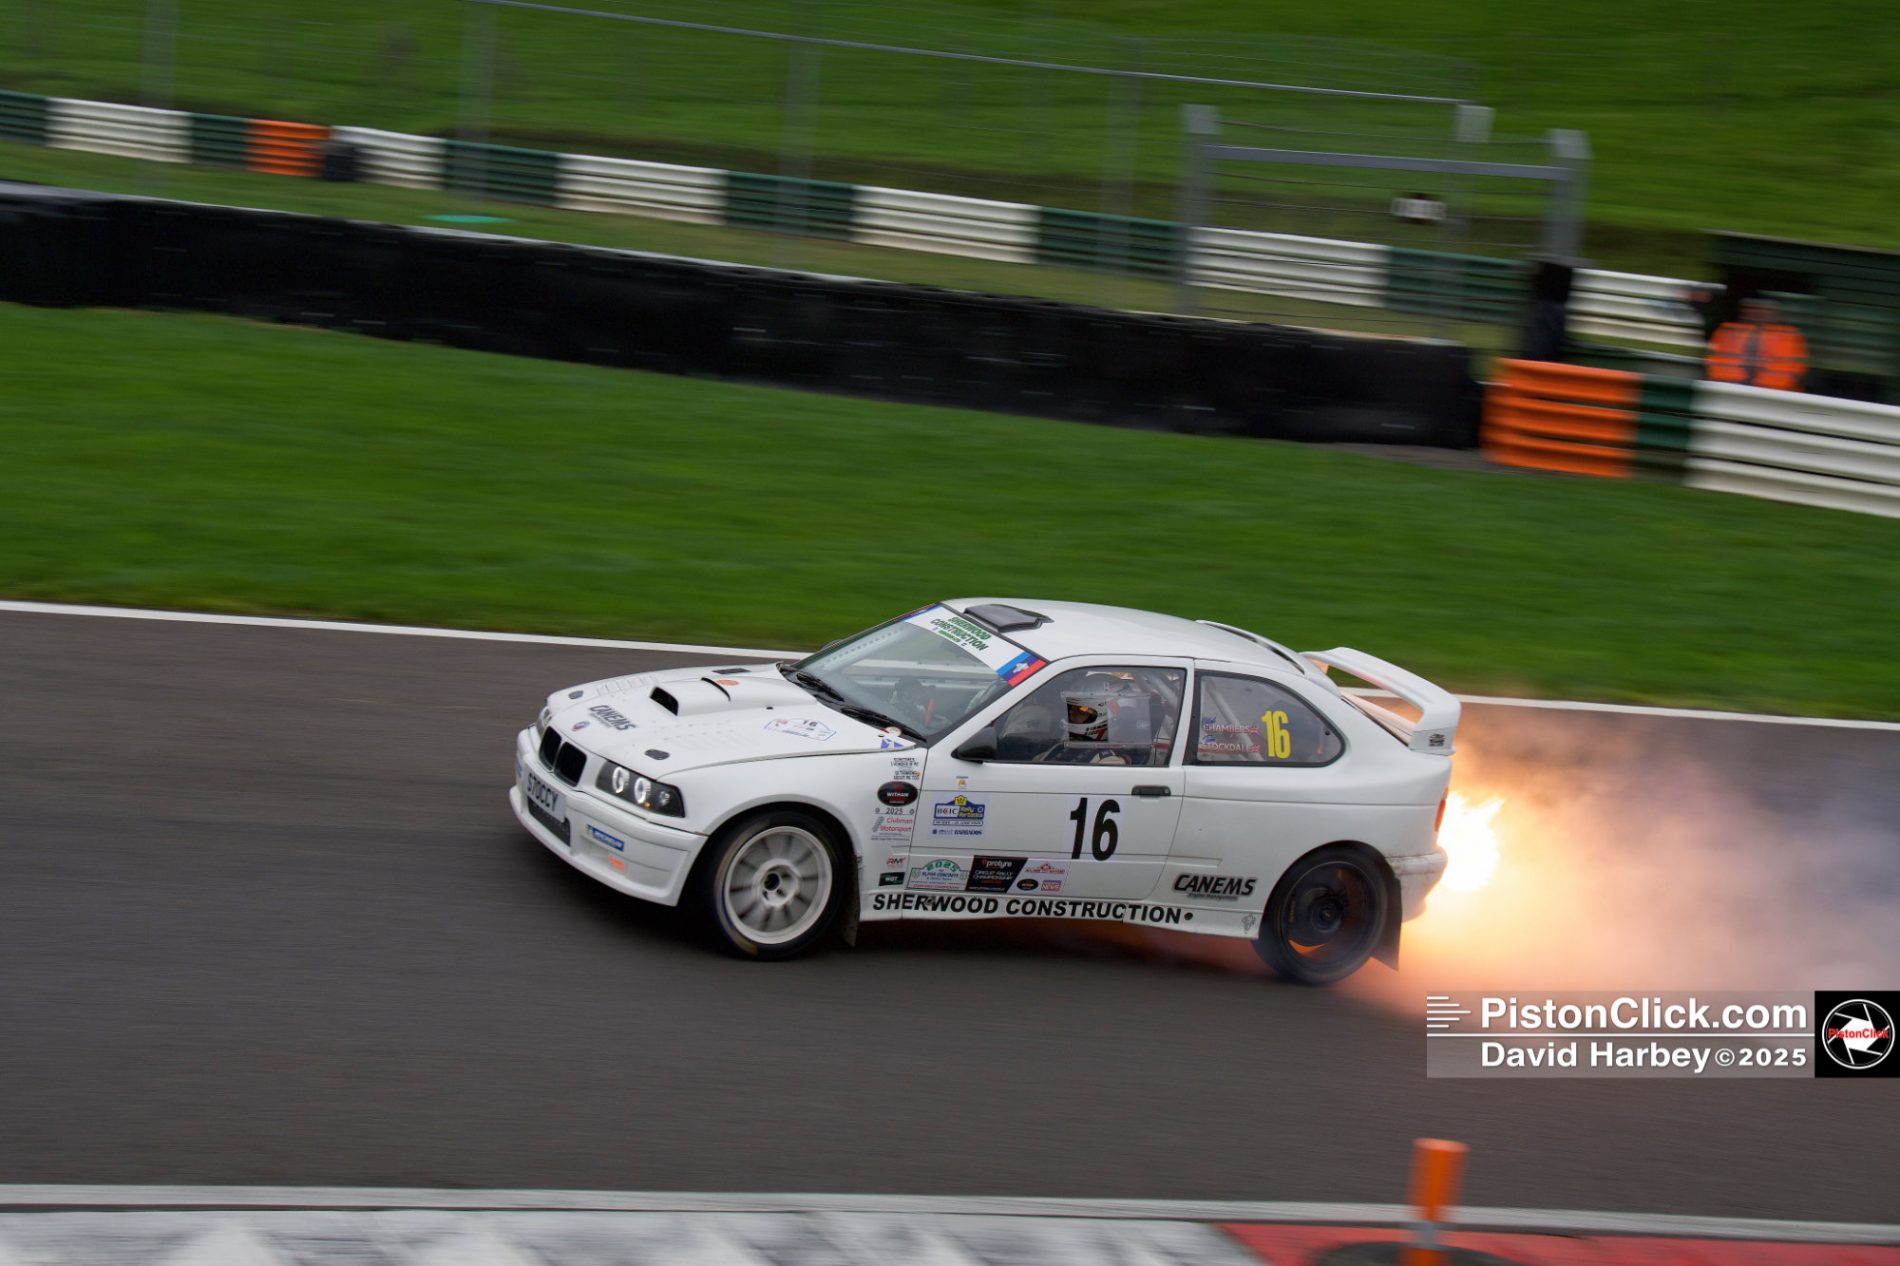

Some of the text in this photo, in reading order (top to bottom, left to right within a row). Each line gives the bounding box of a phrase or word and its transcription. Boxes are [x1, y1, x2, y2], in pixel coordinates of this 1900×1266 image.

[930, 618, 989, 651] CONSTRUCTION
[948, 616, 992, 641] SHERWOOD
[589, 704, 637, 731] CANEMS
[1261, 710, 1291, 759] 16
[886, 807, 904, 815] 2025
[886, 817, 913, 825] Clubman
[1069, 797, 1121, 861] 16
[927, 861, 958, 872] 2025
[986, 860, 1013, 869] protyre
[1174, 873, 1258, 897] CANEMS
[873, 894, 1181, 924] SHERWOOD CONSTRUCTION
